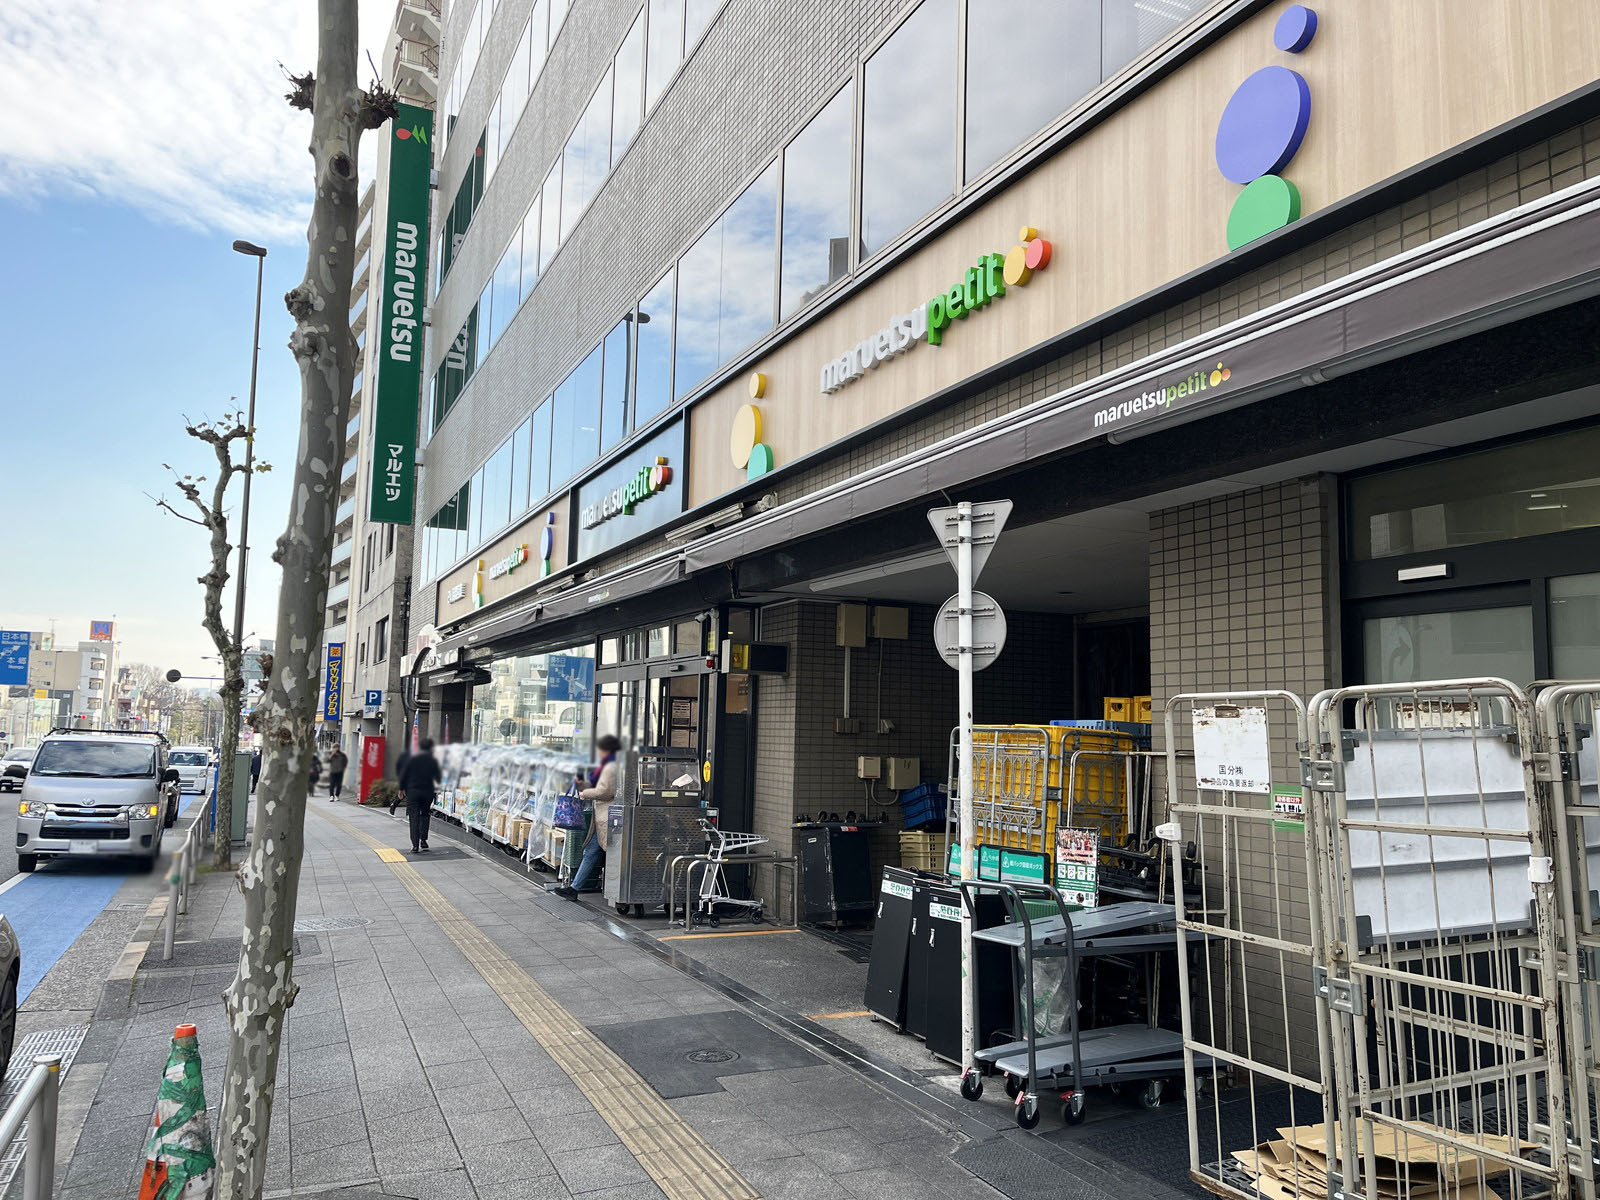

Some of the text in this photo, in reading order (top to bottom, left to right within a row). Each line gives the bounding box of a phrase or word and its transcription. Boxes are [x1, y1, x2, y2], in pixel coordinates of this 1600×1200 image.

[390, 221, 418, 362] maruetsu
[820, 252, 1006, 394] maruetsupetit
[1094, 371, 1207, 428] maruetsupetit
[385, 443, 404, 502] マルエツ
